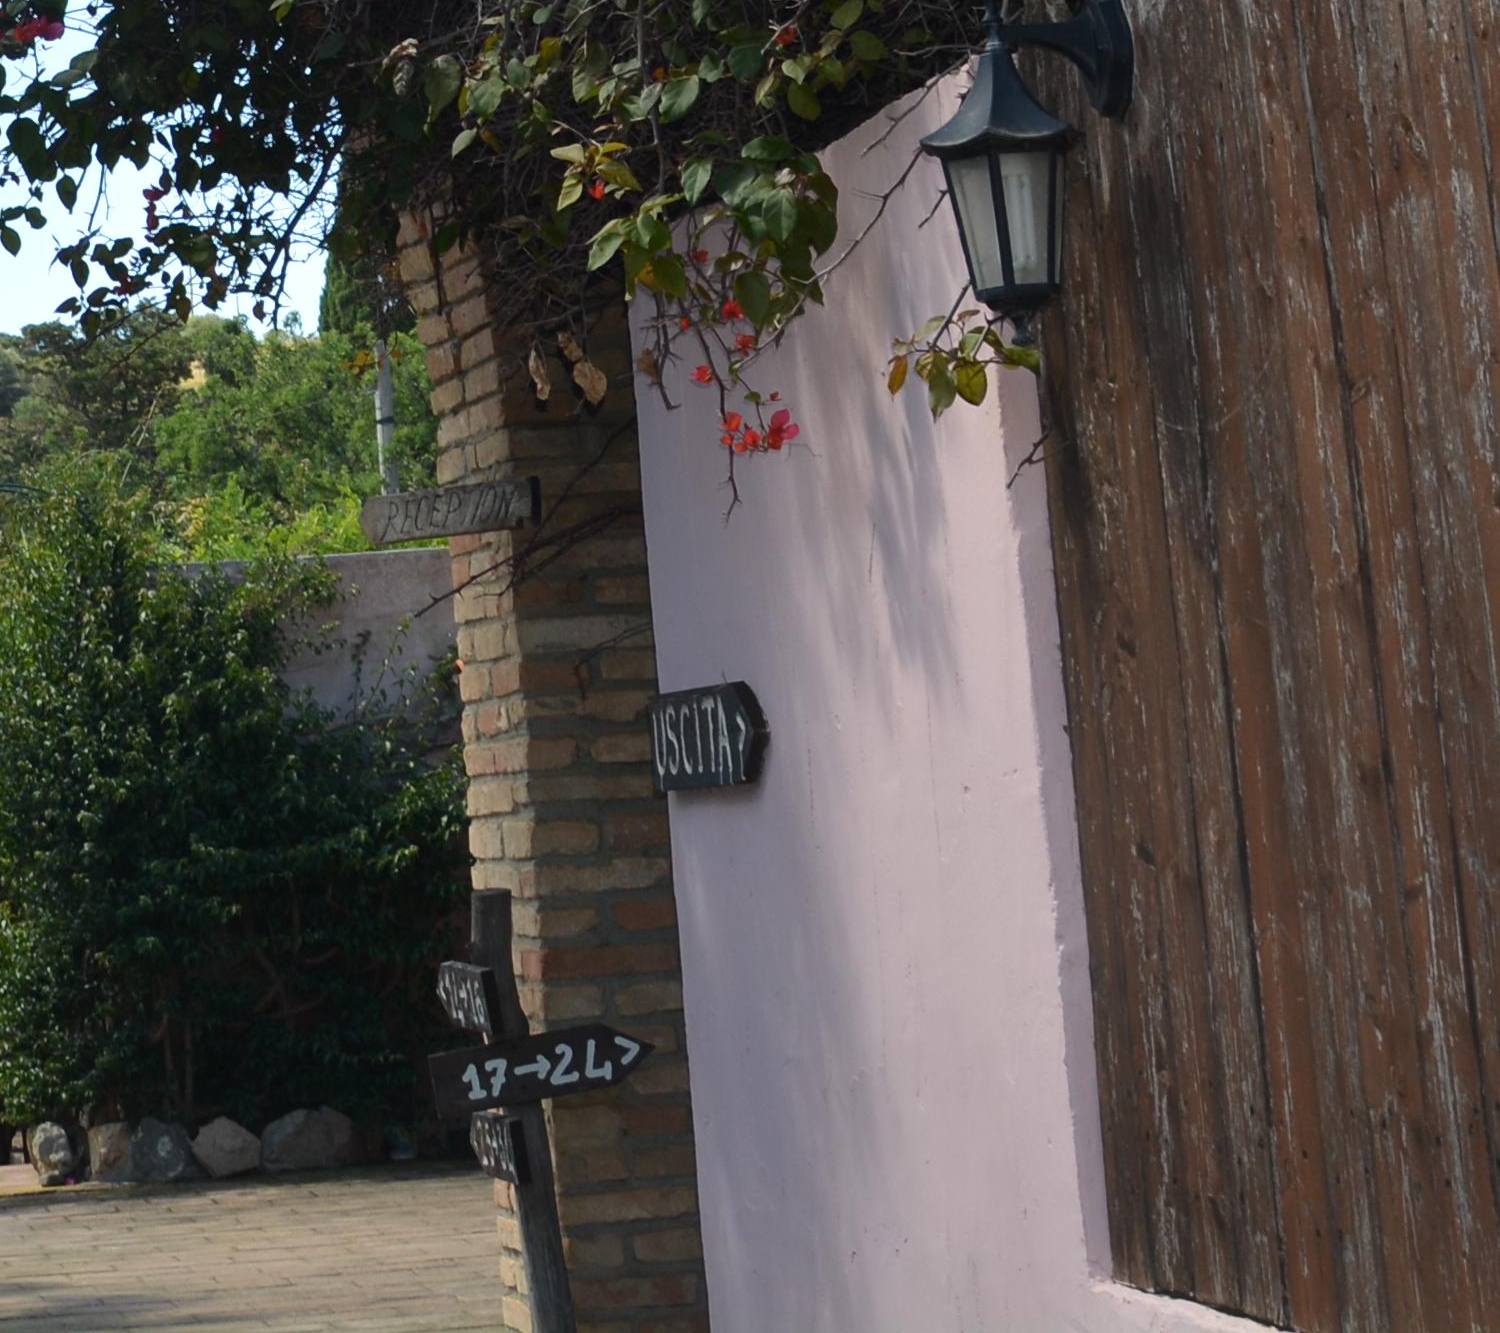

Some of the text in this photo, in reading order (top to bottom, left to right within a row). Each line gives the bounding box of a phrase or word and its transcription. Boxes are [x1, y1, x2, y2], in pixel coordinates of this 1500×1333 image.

[652, 694, 735, 786] USCITA
[462, 1039, 613, 1100] 17 24
